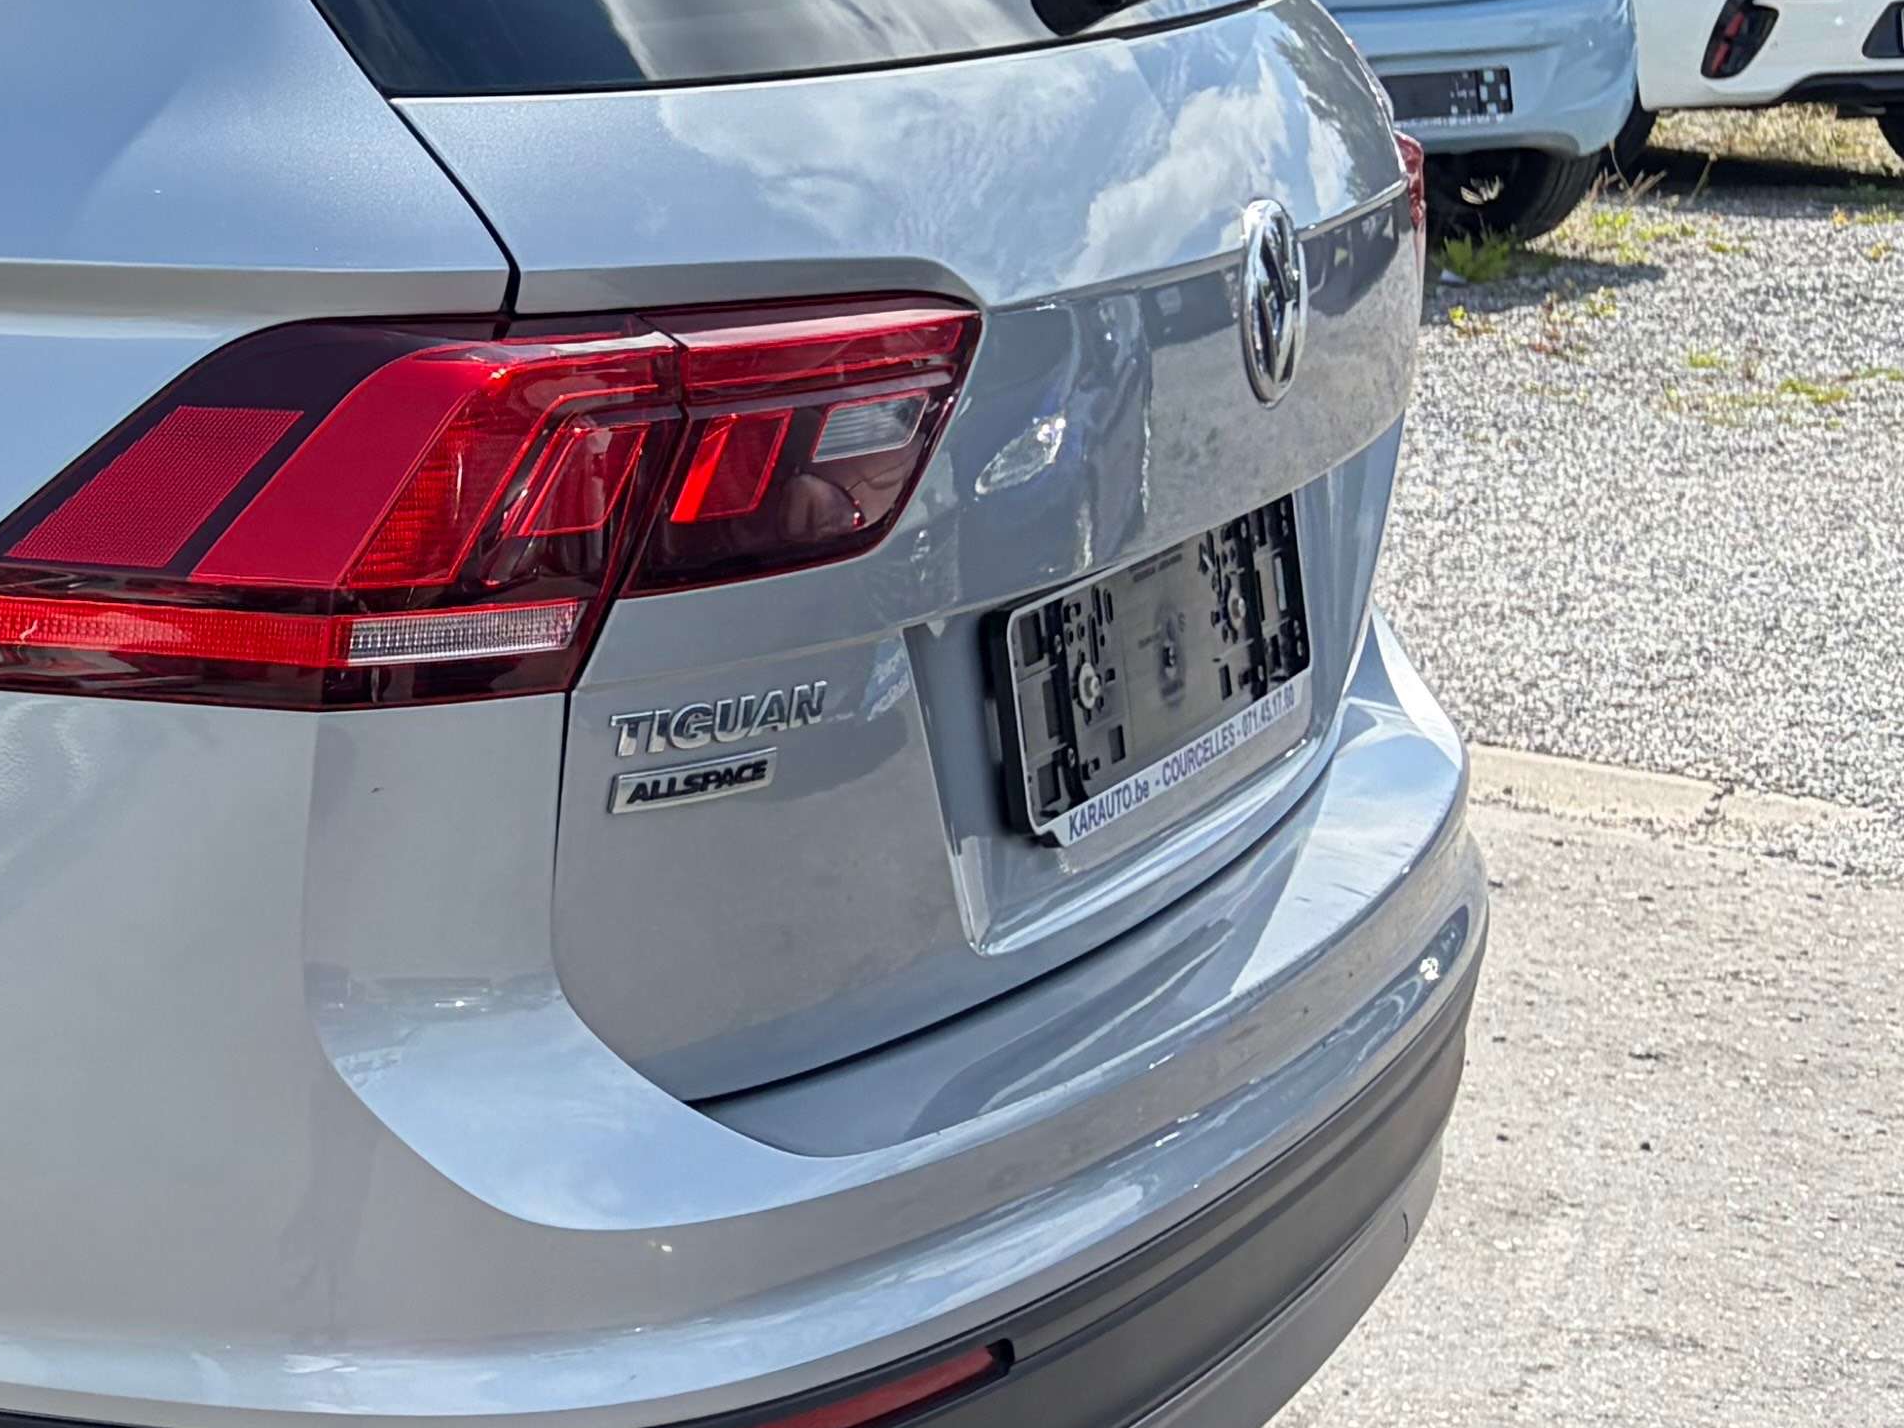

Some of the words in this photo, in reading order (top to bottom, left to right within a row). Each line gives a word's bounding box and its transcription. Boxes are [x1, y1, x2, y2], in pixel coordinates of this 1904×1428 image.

[610, 680, 828, 757] TIGUAN
[626, 759, 769, 805] ALLSPACE
[1068, 778, 1150, 841] KARAUTO.be
[1162, 723, 1236, 787] COURCELLES
